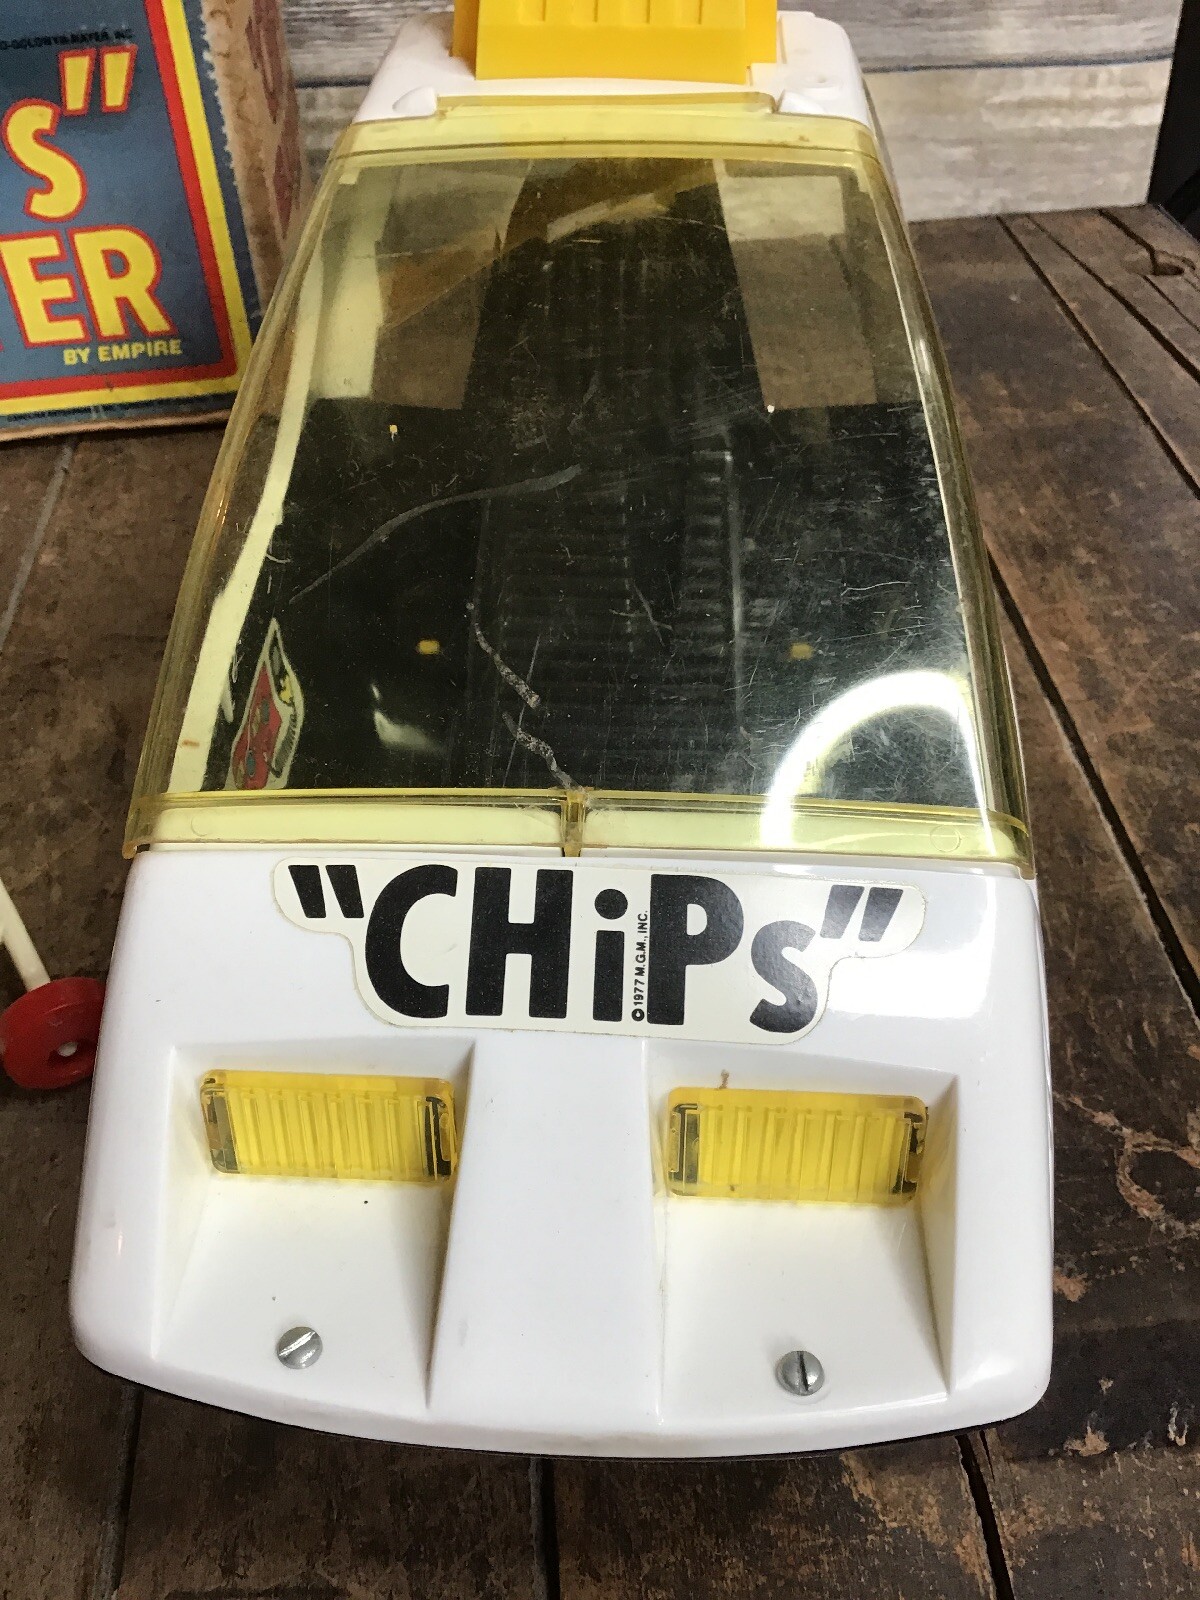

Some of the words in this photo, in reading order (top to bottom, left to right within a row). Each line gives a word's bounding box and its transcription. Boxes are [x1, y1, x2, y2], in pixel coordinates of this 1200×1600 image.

[0, 225, 177, 348] ER
[63, 347, 90, 366] BY
[97, 339, 183, 363] EMPIRE
[637, 910, 649, 934] INC.
